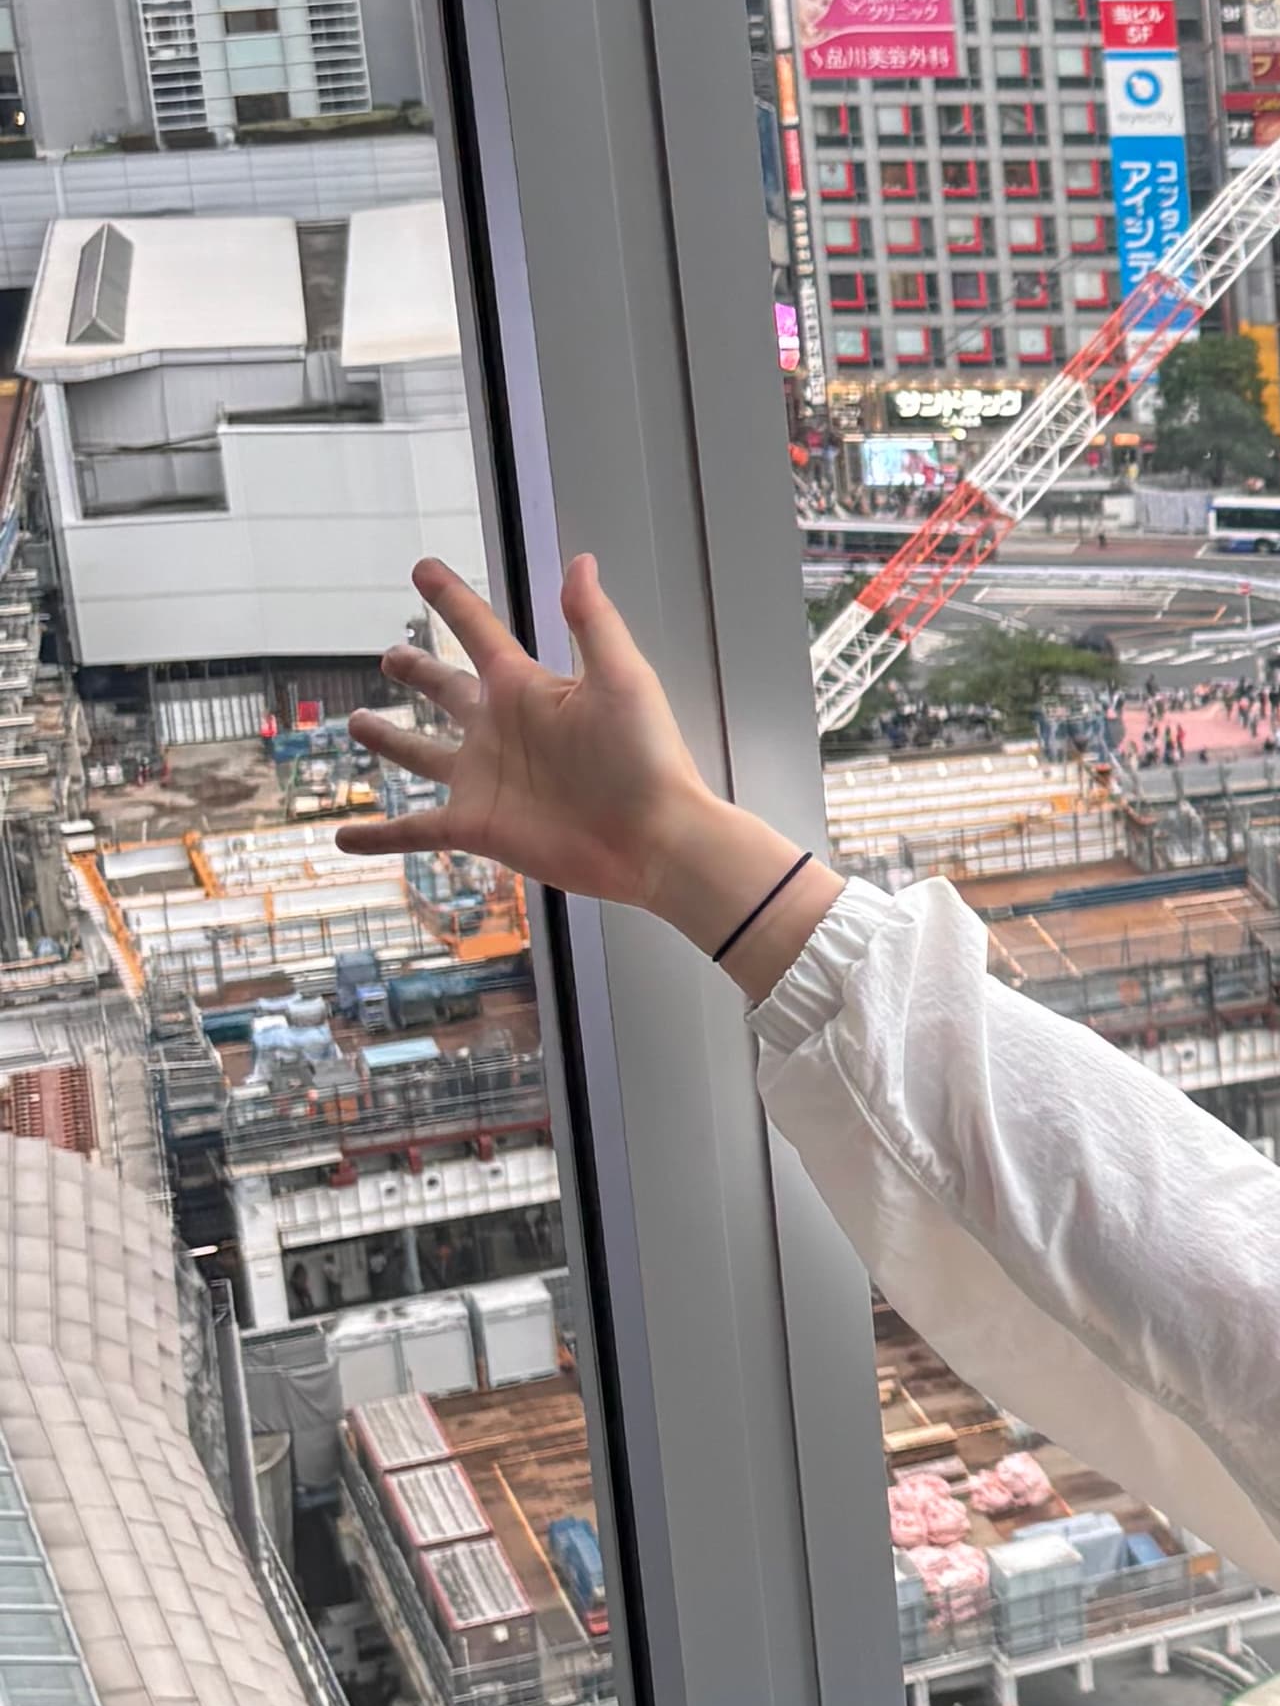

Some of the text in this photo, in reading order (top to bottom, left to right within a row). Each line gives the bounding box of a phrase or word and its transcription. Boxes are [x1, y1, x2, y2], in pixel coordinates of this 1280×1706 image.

[896, 390, 1023, 419] サンドラッグ
